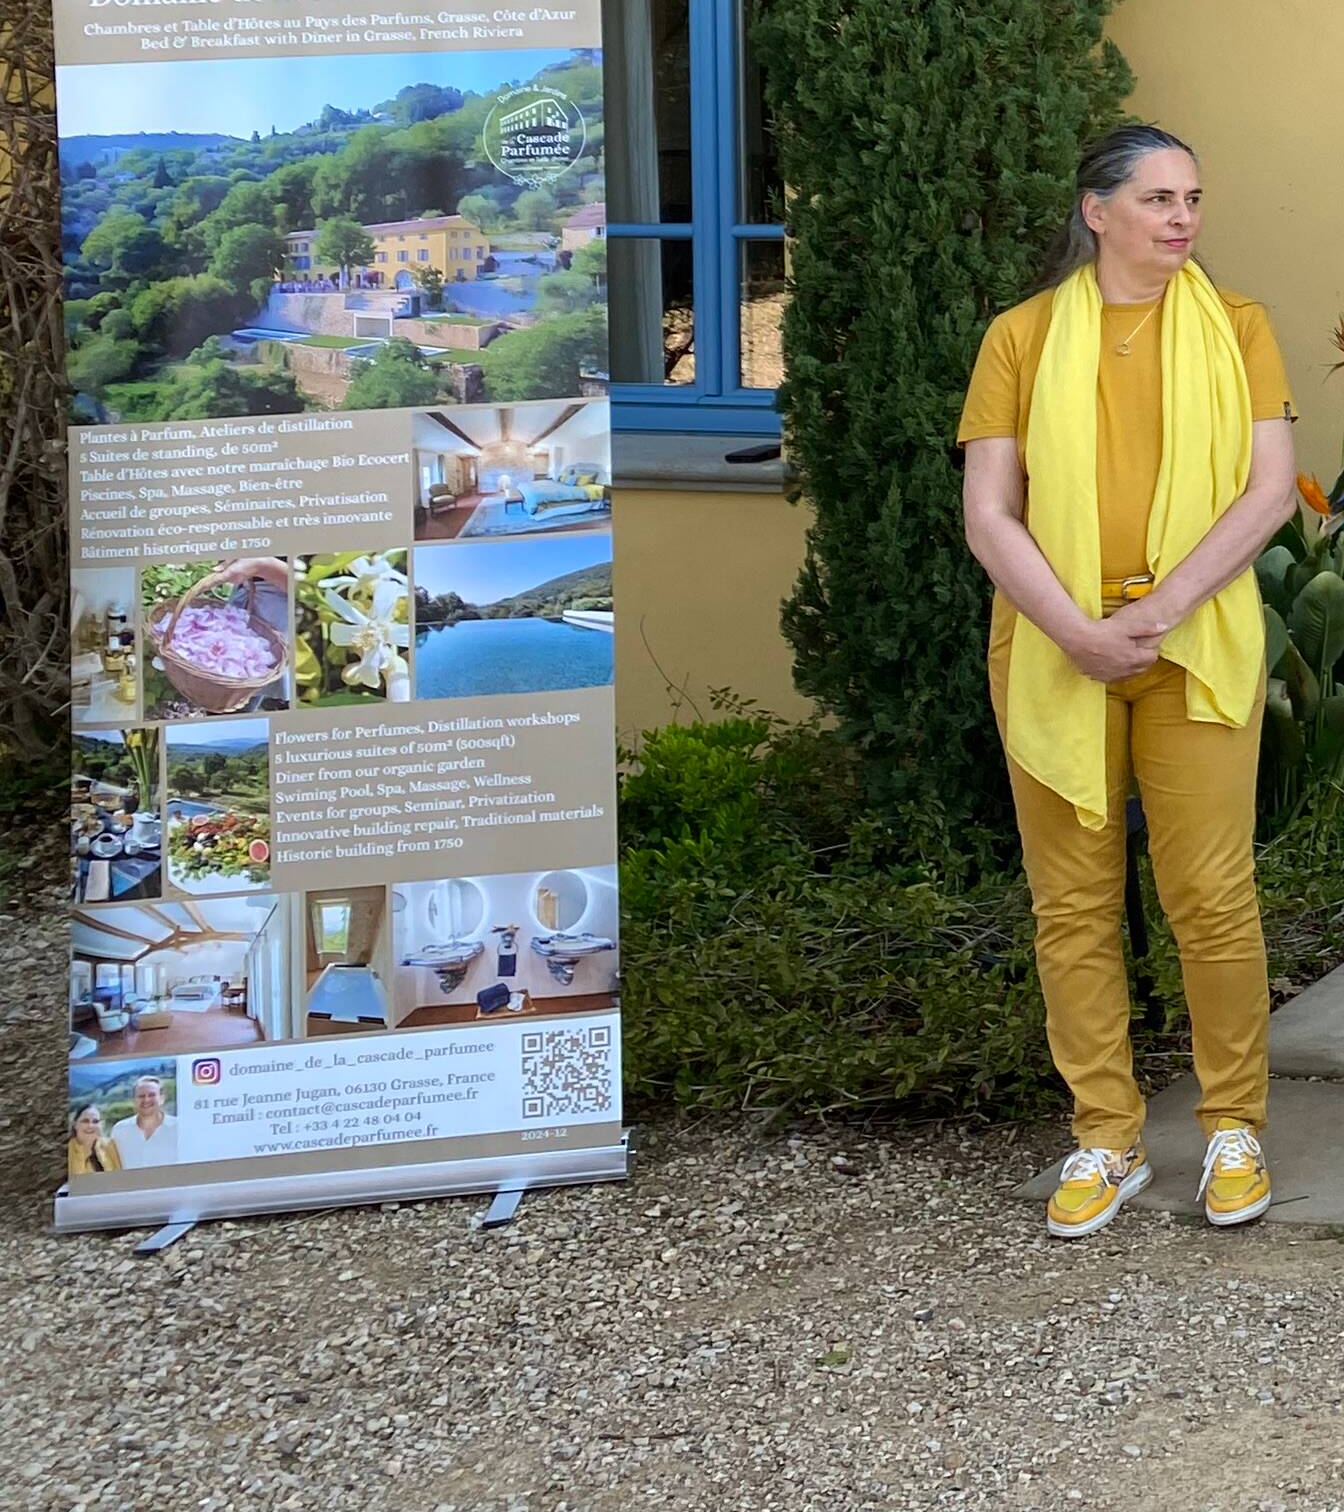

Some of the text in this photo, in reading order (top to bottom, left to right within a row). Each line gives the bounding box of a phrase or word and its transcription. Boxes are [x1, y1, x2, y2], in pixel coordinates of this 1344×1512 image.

[84, 22, 160, 35] Chambres
[164, 22, 177, 32] et
[182, 19, 219, 32] Table
[284, 19, 300, 29] au
[305, 13, 338, 30] Pays
[342, 15, 366, 26] des
[371, 12, 434, 25] Parfums,
[438, 12, 489, 24] Grasse,
[493, 9, 525, 22] Côte
[141, 25, 524, 50] Bed & Breakfast with Diner in Grasse, French Riviera
[501, 144, 570, 156] Parfumée
[517, 132, 570, 144] Cascade
[80, 418, 353, 444] Plantes à Parfum, Ateliers de distillation
[80, 455, 86, 463] 5
[89, 451, 130, 463] Suites
[132, 448, 149, 460] de
[152, 446, 218, 459] standing,
[221, 443, 238, 455] de
[80, 469, 113, 482] Table
[171, 467, 203, 477] avec
[207, 463, 245, 475] notre
[250, 457, 328, 472] maraîchage
[332, 454, 354, 467] Bio
[358, 453, 409, 466] Ecocert
[81, 478, 303, 501] Piscines, Spa, Massage, Bien-être
[80, 491, 387, 520] Accueil de groupes, Séminaires, Privatisation
[81, 510, 392, 539] Rénovation éco-responsable et très innovante
[81, 538, 270, 558] Bâtiment historique de 1750
[275, 712, 580, 745] Flowers for Perfumes, Distillation workshops
[275, 754, 282, 764] 5
[286, 749, 352, 763] luxurious
[356, 745, 397, 757] suites
[400, 741, 415, 754] of
[456, 734, 516, 752] (500sqft)
[276, 756, 485, 784] Diner from our organic garden
[275, 774, 532, 804] Swiming Pool, Spa, Massage, Wellness
[276, 791, 555, 823] Events for groups, Seminar, Privatization
[277, 804, 604, 843] Innovative building repair, Traditional materials
[277, 837, 463, 862] Historic building from 1750
[229, 1042, 494, 1076] domaine_de_la_cascade_parfumee
[194, 1072, 495, 1110] 81 rue Jeanne Jugan, 06130 Grasse, France
[212, 1109, 254, 1124] Email
[266, 1087, 479, 1119] contact@cascadeparfumee.fr
[270, 1122, 292, 1135] Tel
[304, 1120, 328, 1132] +33
[331, 1120, 339, 1128] 4
[344, 1118, 359, 1128] 22
[364, 1116, 379, 1125] 48
[384, 1114, 400, 1124] 04
[405, 1112, 421, 1122] 04
[254, 1124, 439, 1153] www.cascadeparfumee.fr
